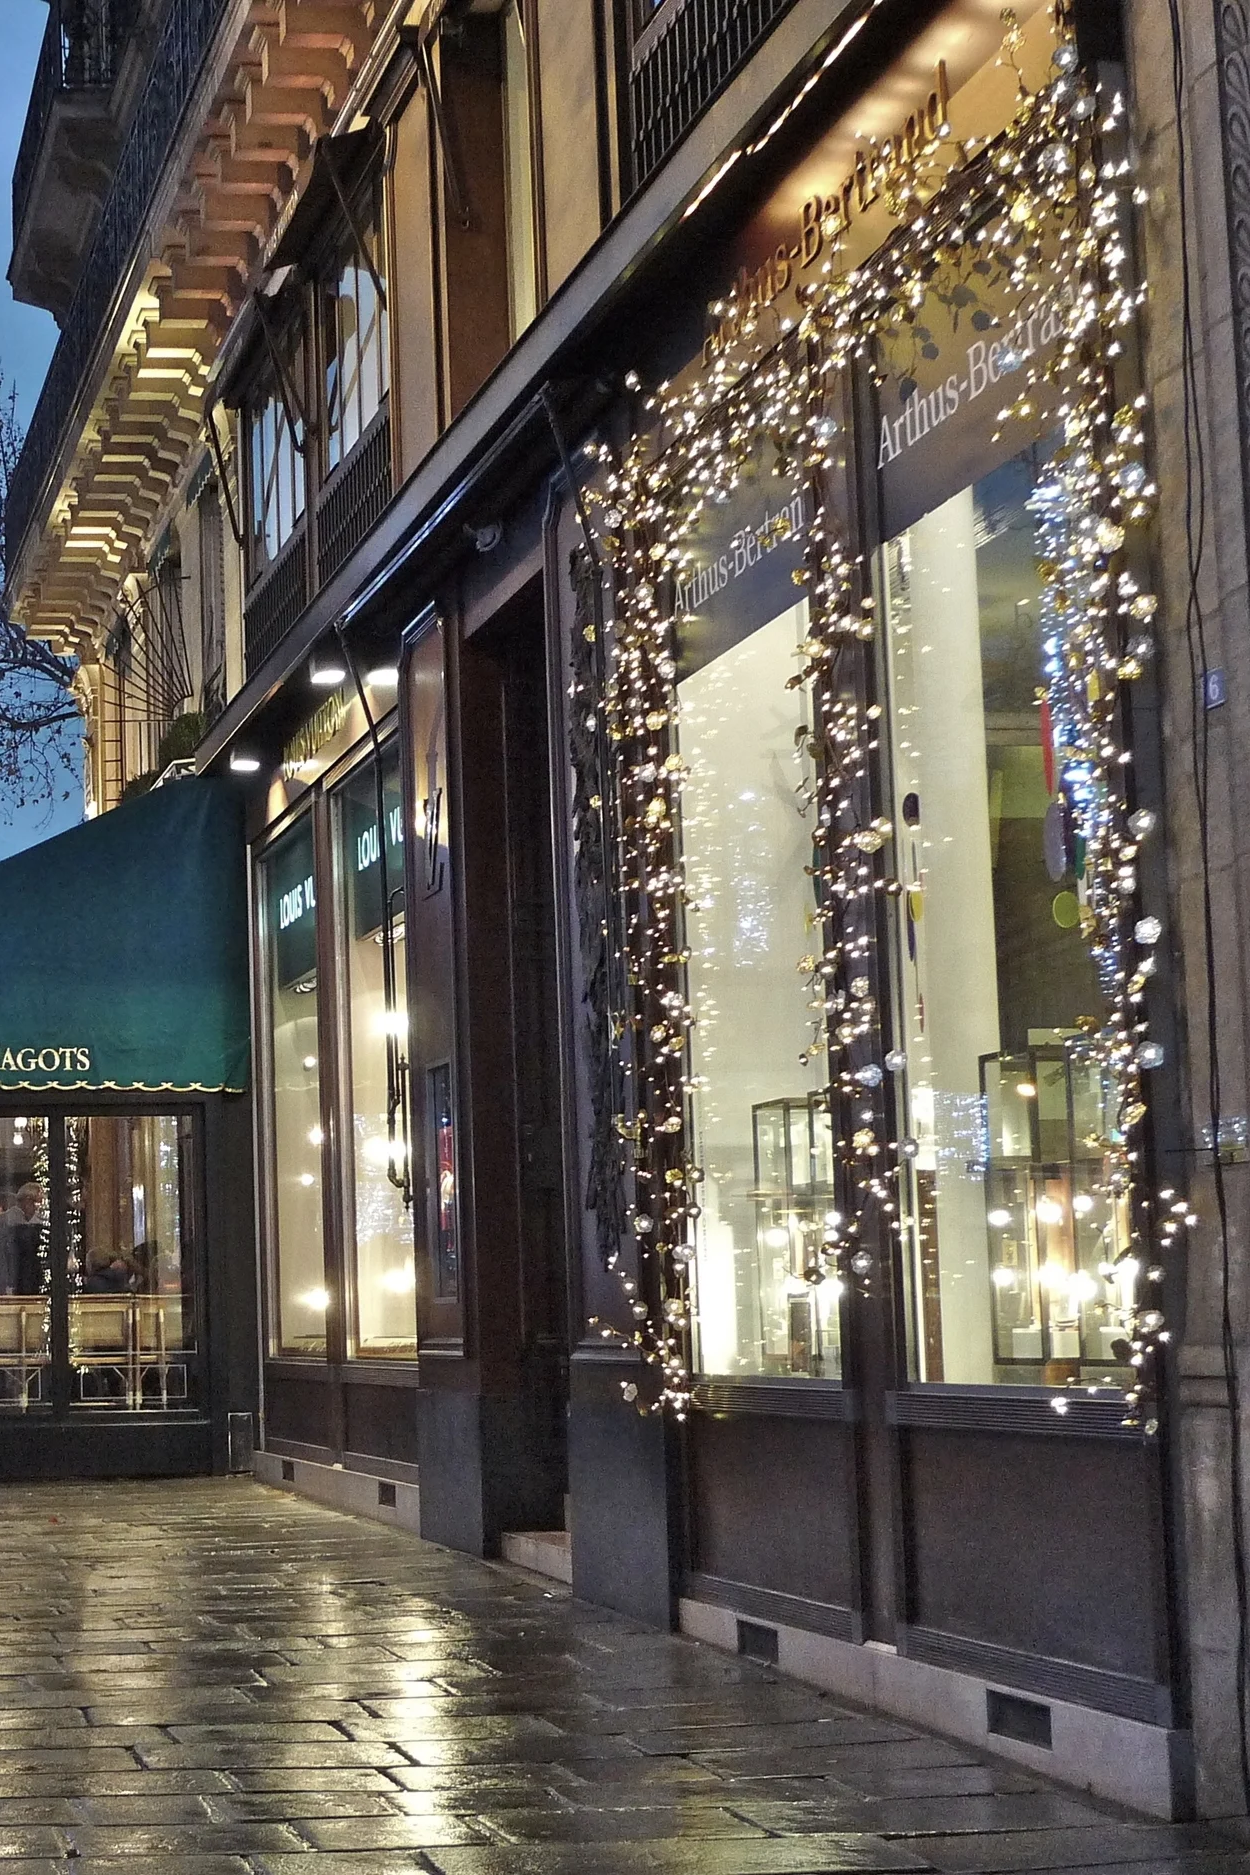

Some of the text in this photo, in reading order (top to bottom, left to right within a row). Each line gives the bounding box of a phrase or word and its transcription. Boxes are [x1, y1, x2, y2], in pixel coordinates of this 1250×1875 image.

[876, 283, 1075, 470] Arthus-Bertra
[674, 495, 805, 618] Arthus-Bertran
[279, 883, 303, 930] LOUIS
